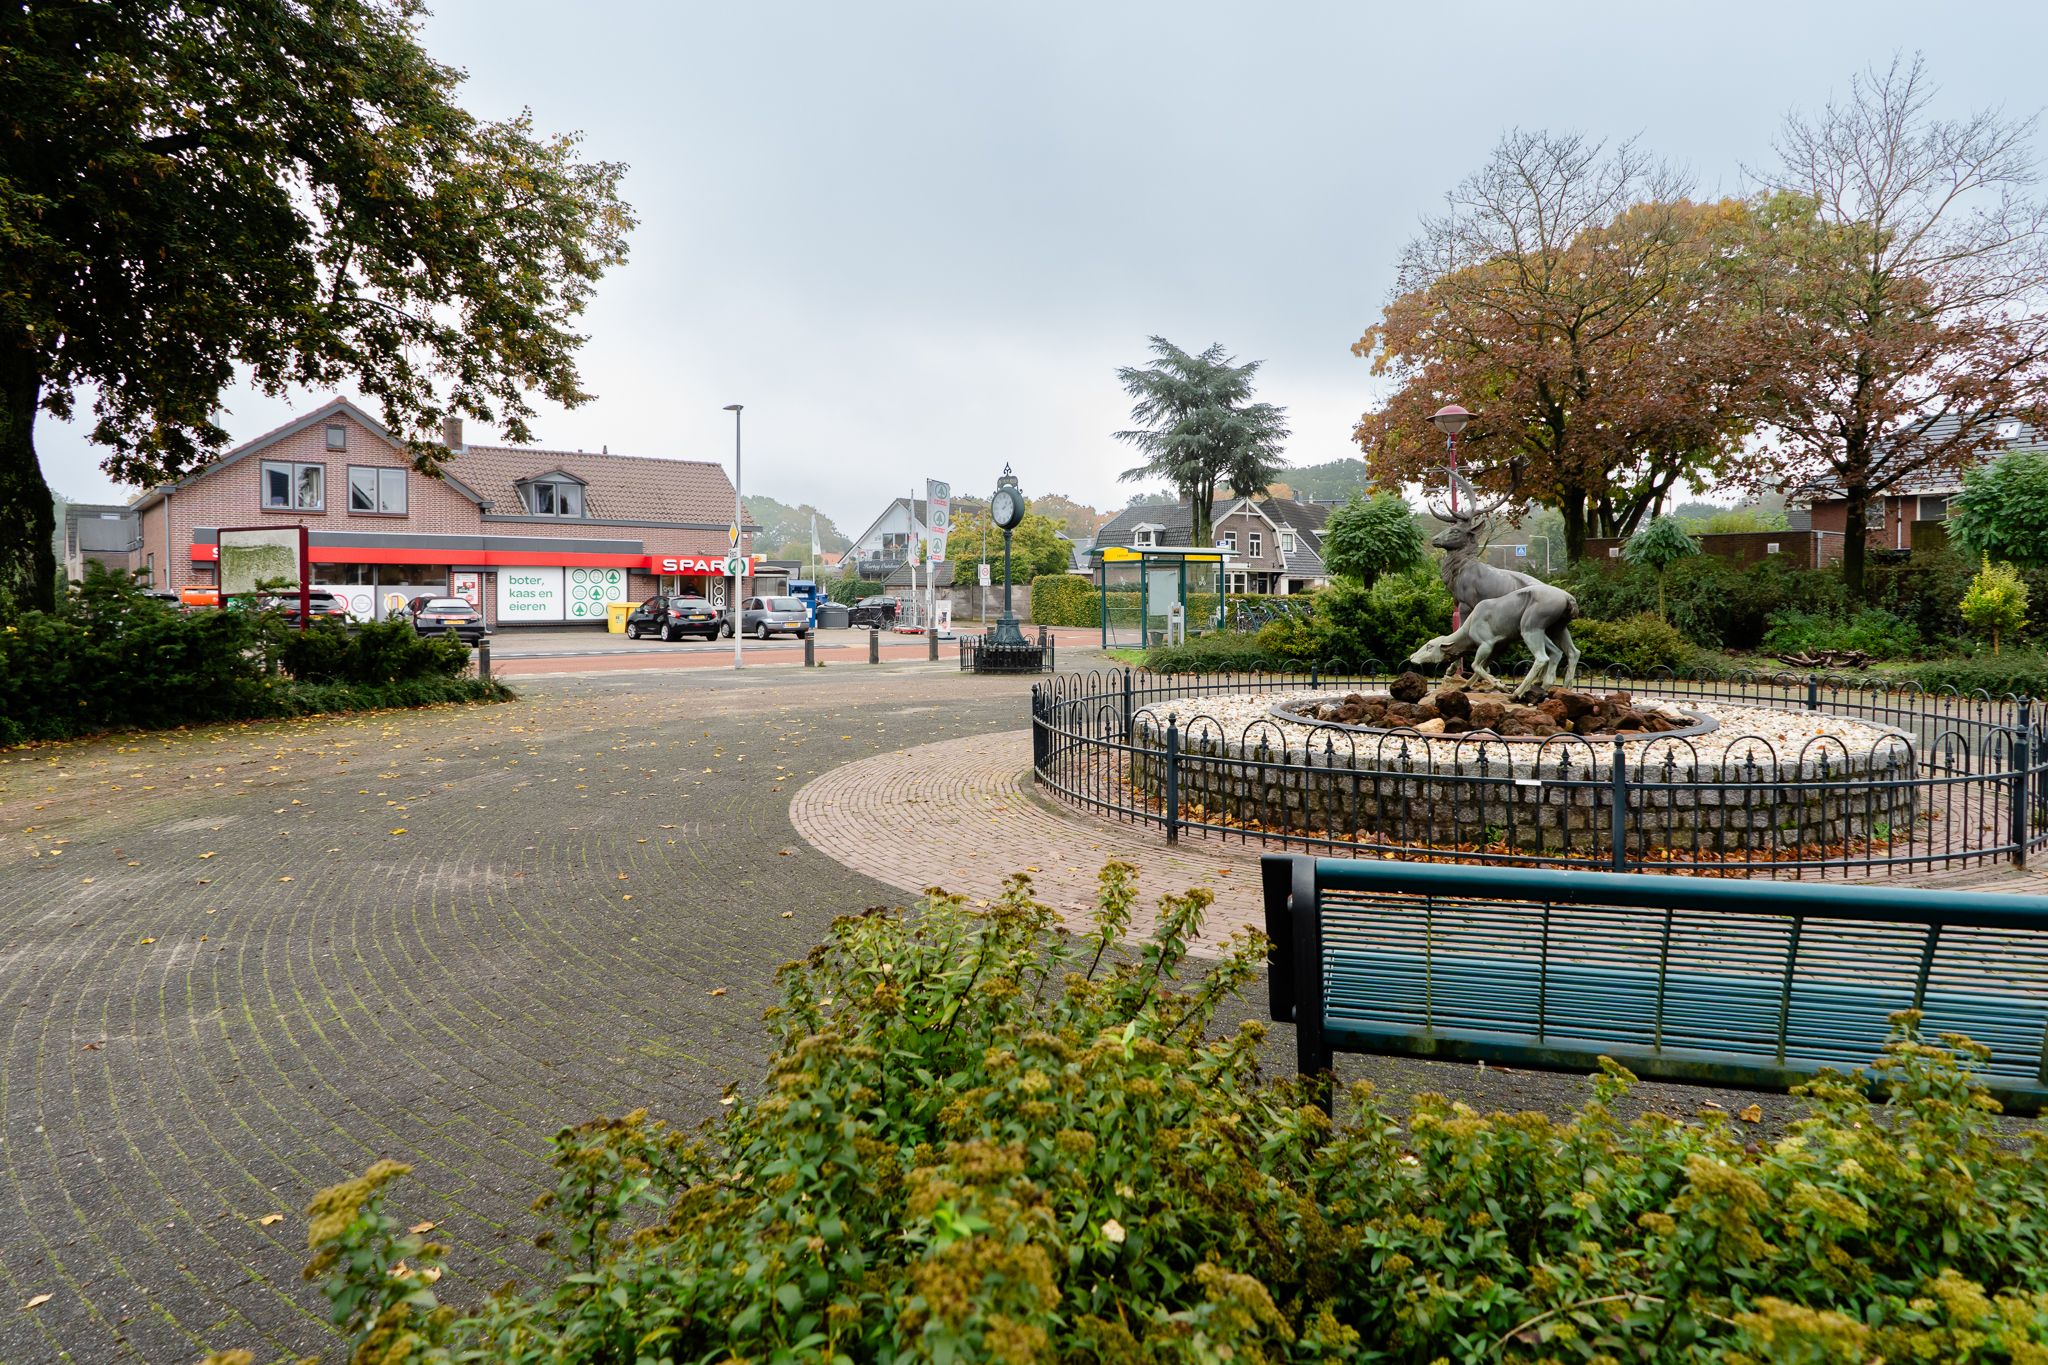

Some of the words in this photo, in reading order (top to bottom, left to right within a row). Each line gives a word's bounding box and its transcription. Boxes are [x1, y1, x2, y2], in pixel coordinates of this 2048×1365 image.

[662, 558, 725, 572] SPAR
[509, 575, 544, 586] boter,
[509, 588, 536, 598] kaas
[538, 590, 553, 598] en
[509, 600, 546, 611] eieren
